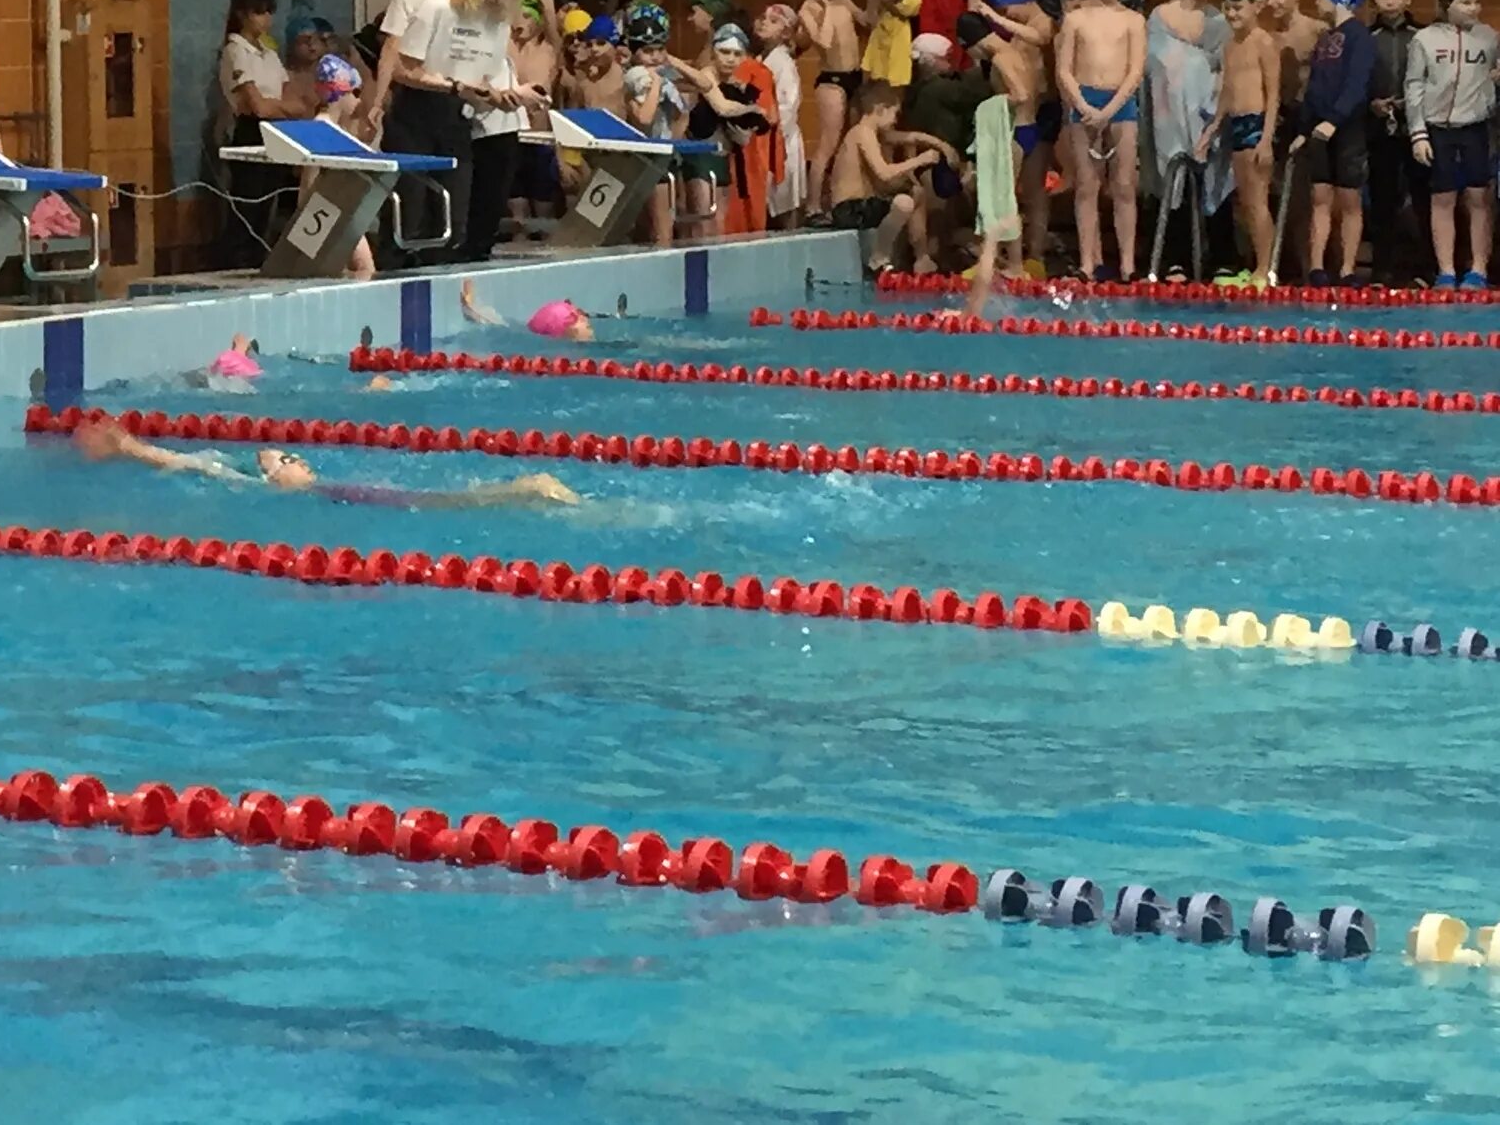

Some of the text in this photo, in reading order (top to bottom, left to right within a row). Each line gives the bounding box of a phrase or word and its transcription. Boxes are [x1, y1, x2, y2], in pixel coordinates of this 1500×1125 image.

[1435, 49, 1487, 64] FILA
[589, 183, 610, 208] 6
[303, 208, 330, 236] 5
